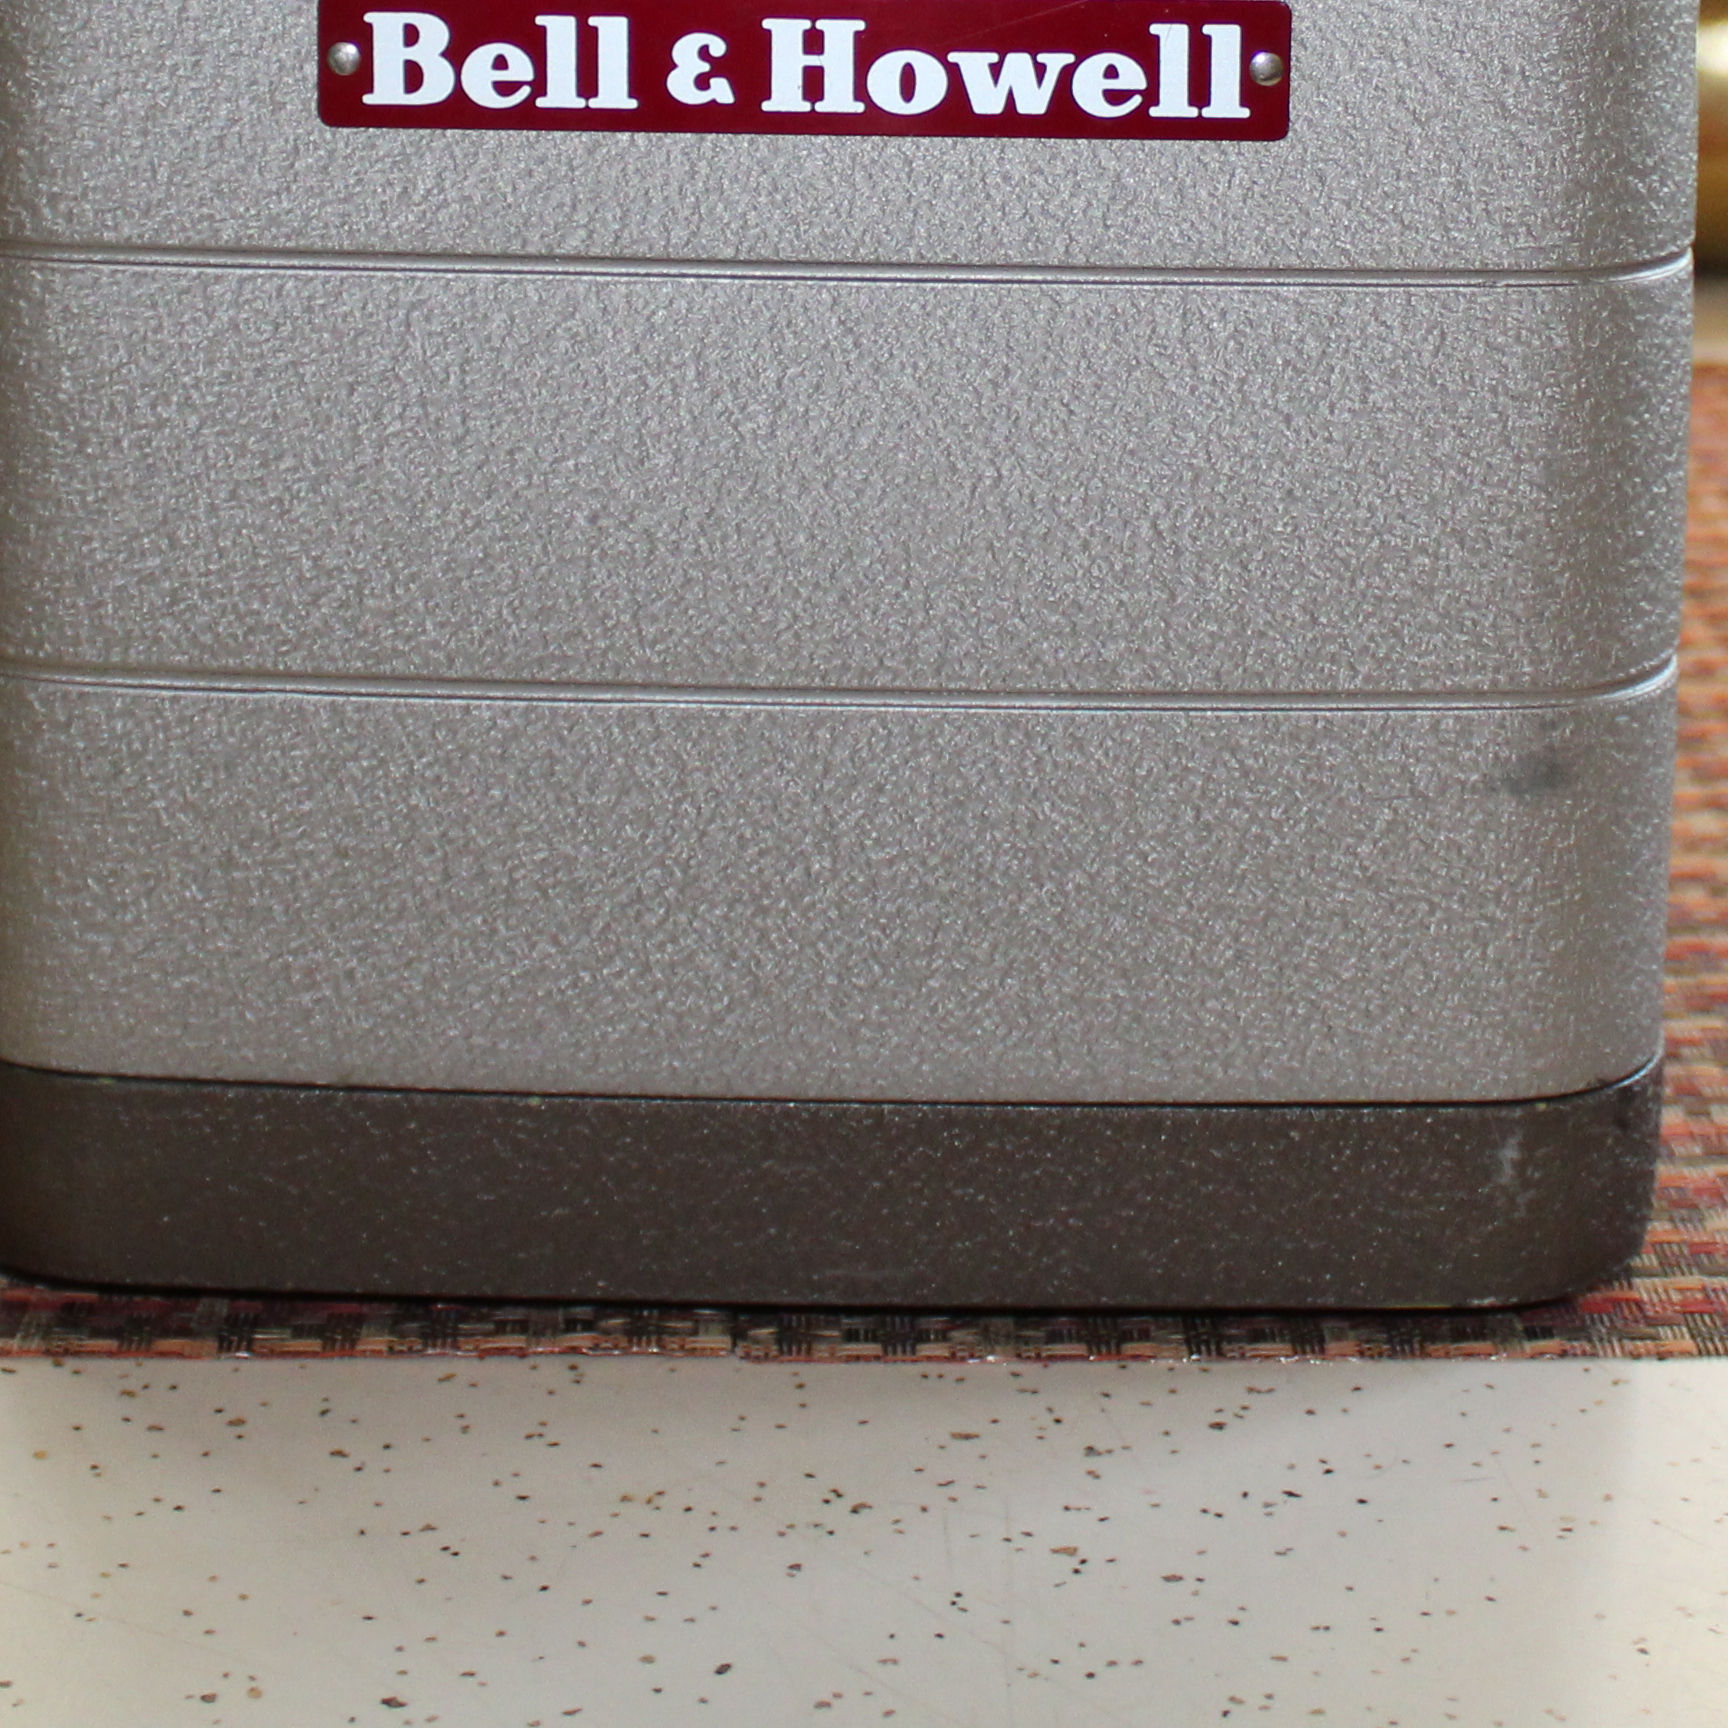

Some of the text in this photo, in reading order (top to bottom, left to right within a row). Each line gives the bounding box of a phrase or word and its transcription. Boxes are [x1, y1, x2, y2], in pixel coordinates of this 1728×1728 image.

[363, 12, 1250, 118] Bell & Howell
